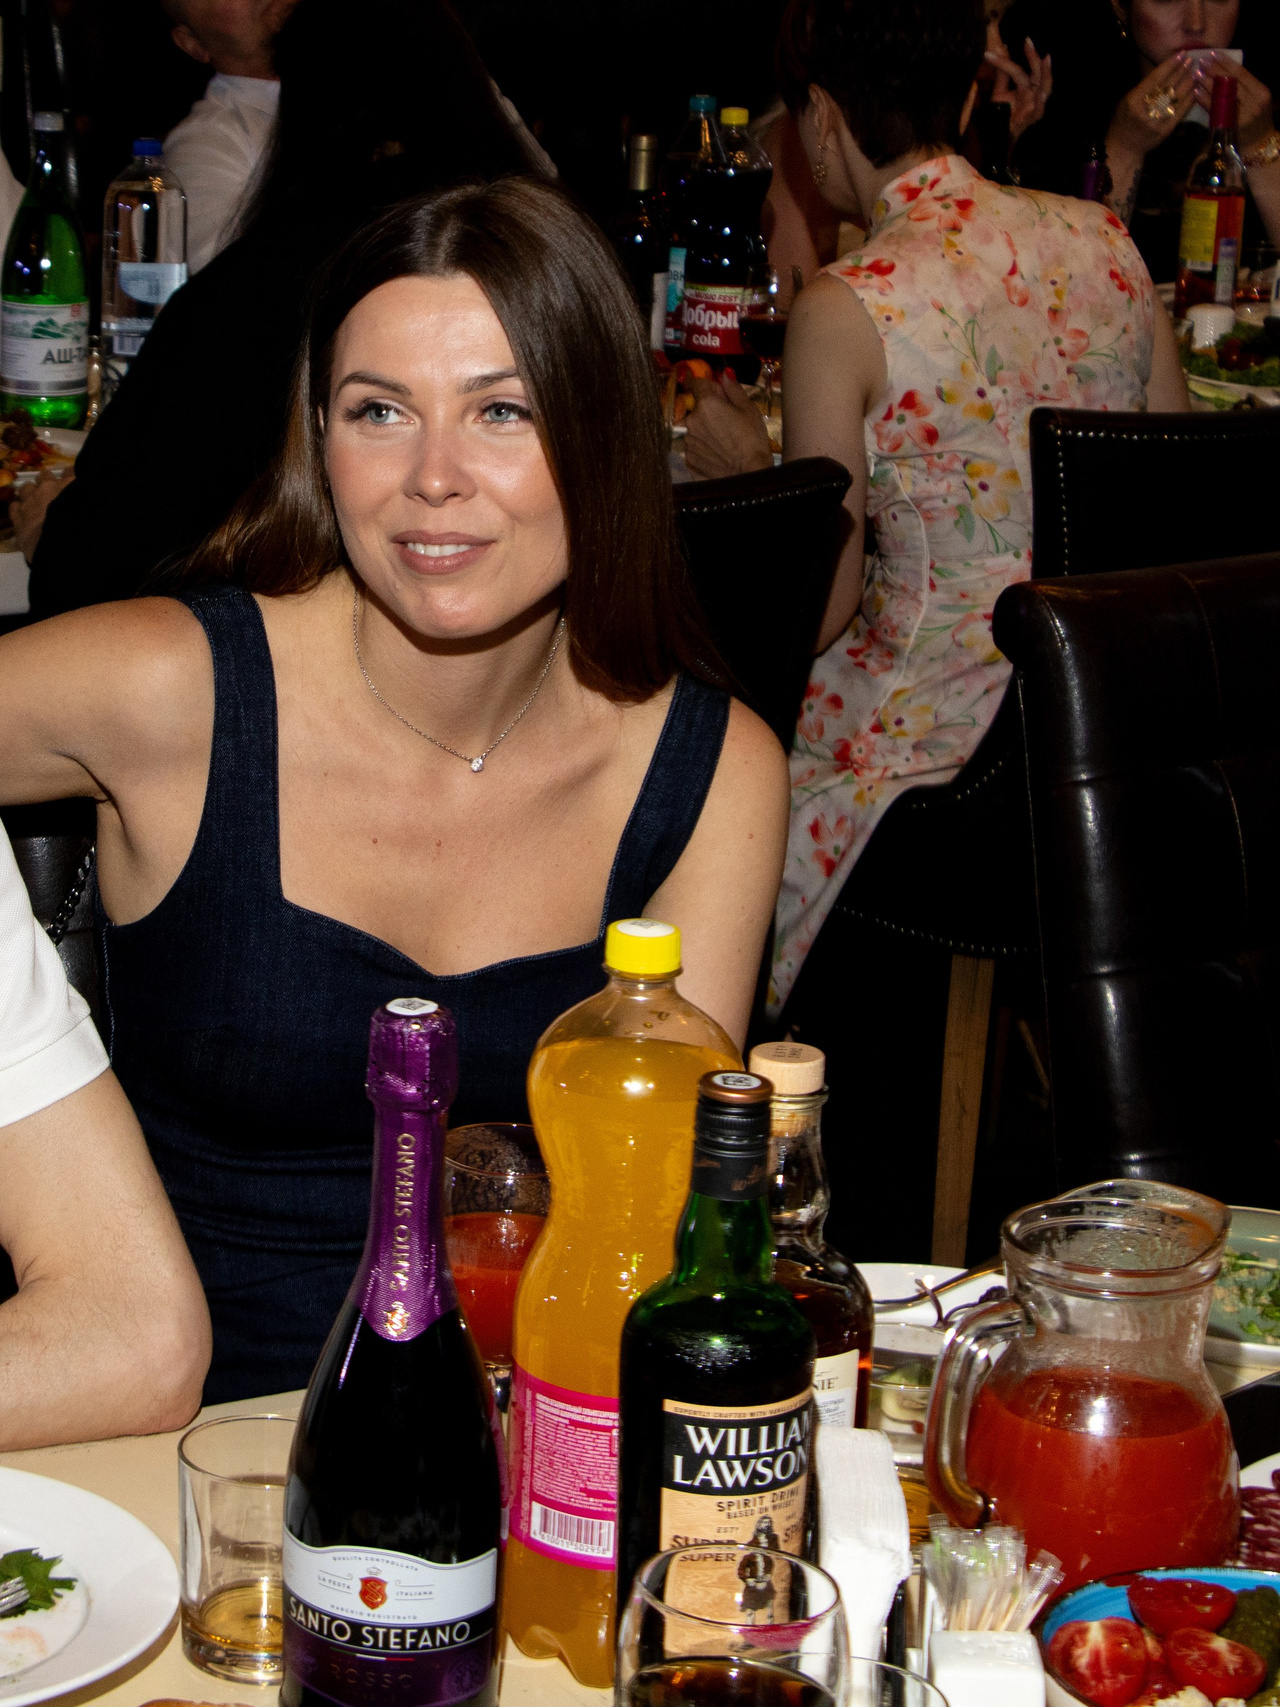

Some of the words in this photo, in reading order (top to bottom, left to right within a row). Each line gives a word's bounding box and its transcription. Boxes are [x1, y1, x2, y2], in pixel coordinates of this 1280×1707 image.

[692, 332, 721, 347] cola
[393, 1133, 417, 1218] STEFANO
[389, 1225, 411, 1291] SANTO
[716, 1495, 767, 1512] SPIRIT
[725, 1508, 756, 1519] BASED
[758, 1505, 770, 1515] ON
[289, 1596, 352, 1642] SANTO
[360, 1620, 471, 1650] STEFANO
